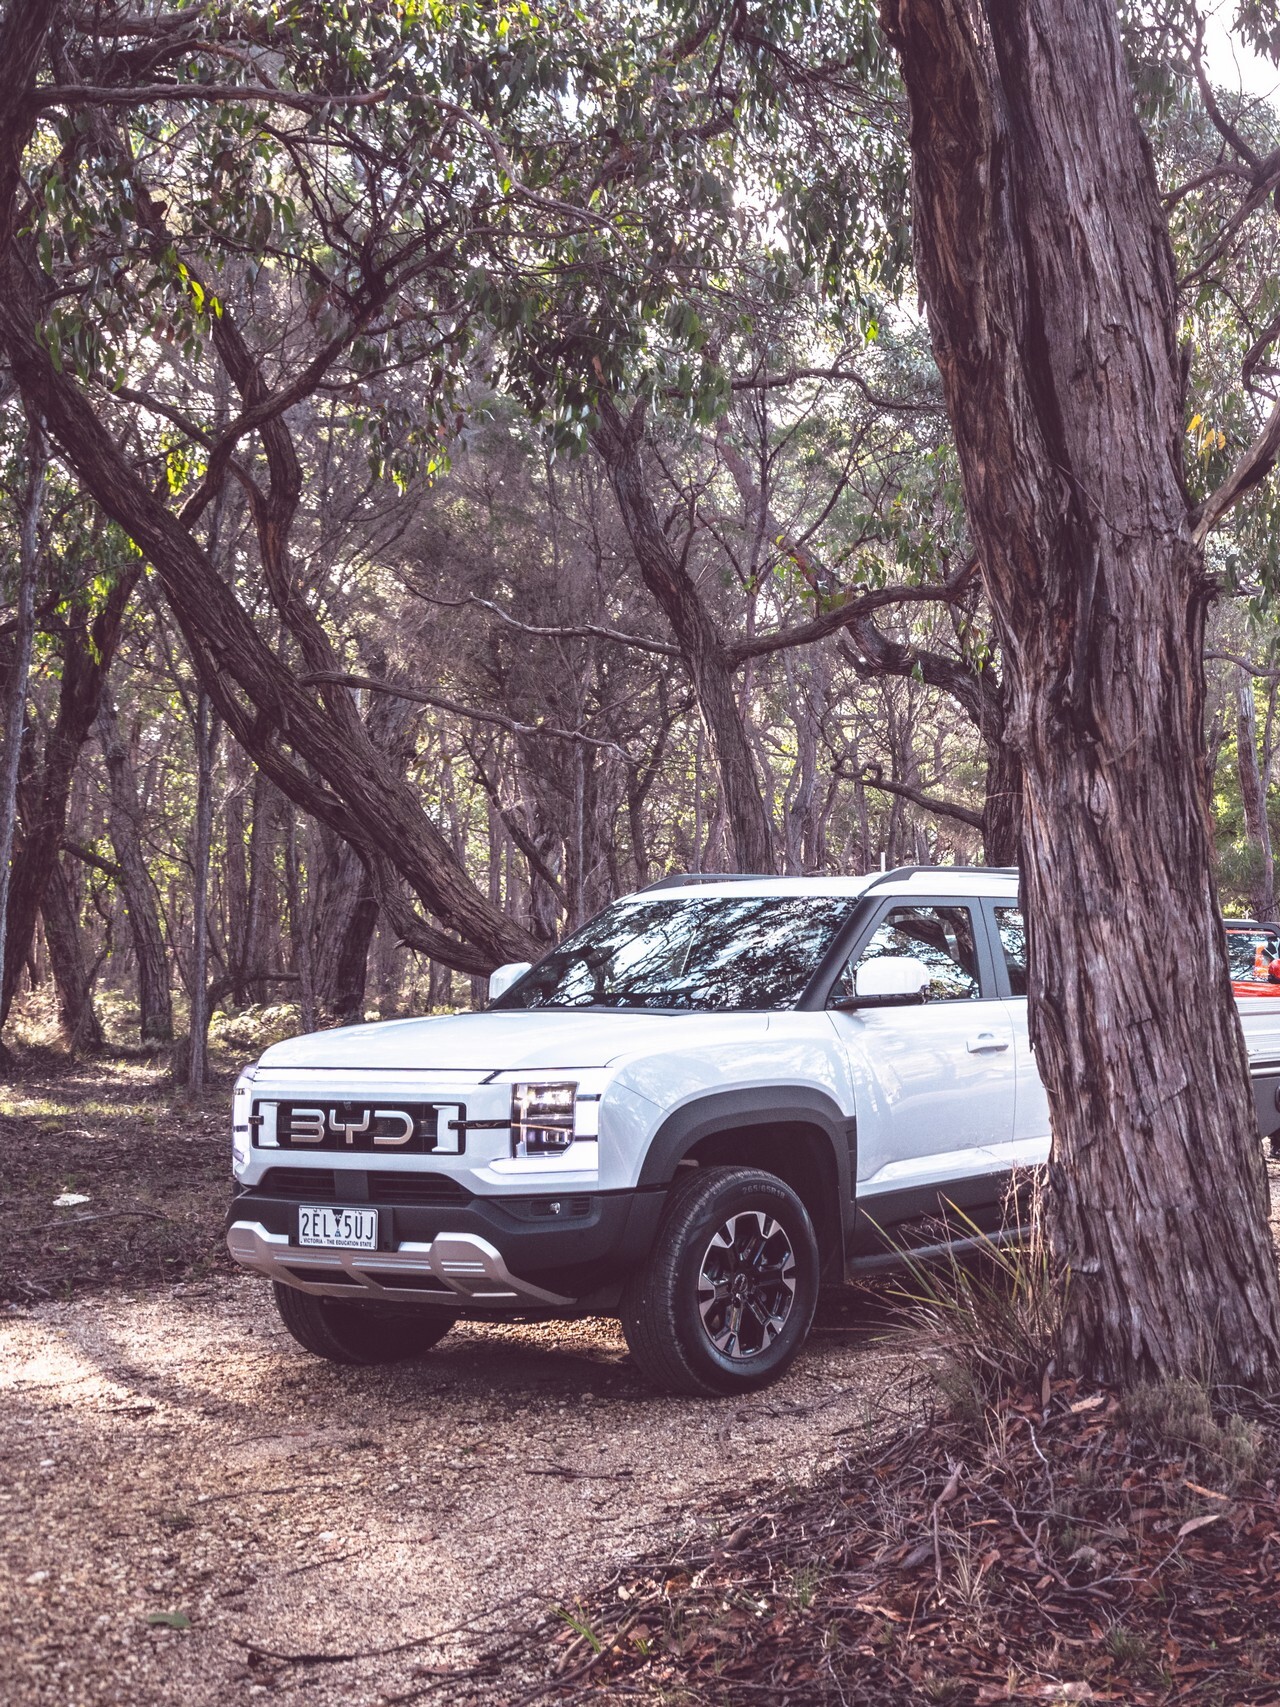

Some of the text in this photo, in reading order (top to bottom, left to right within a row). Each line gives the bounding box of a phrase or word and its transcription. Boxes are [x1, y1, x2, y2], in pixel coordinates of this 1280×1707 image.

[291, 1108, 414, 1145] BYD
[302, 1213, 373, 1240] 2EL 5UJ
